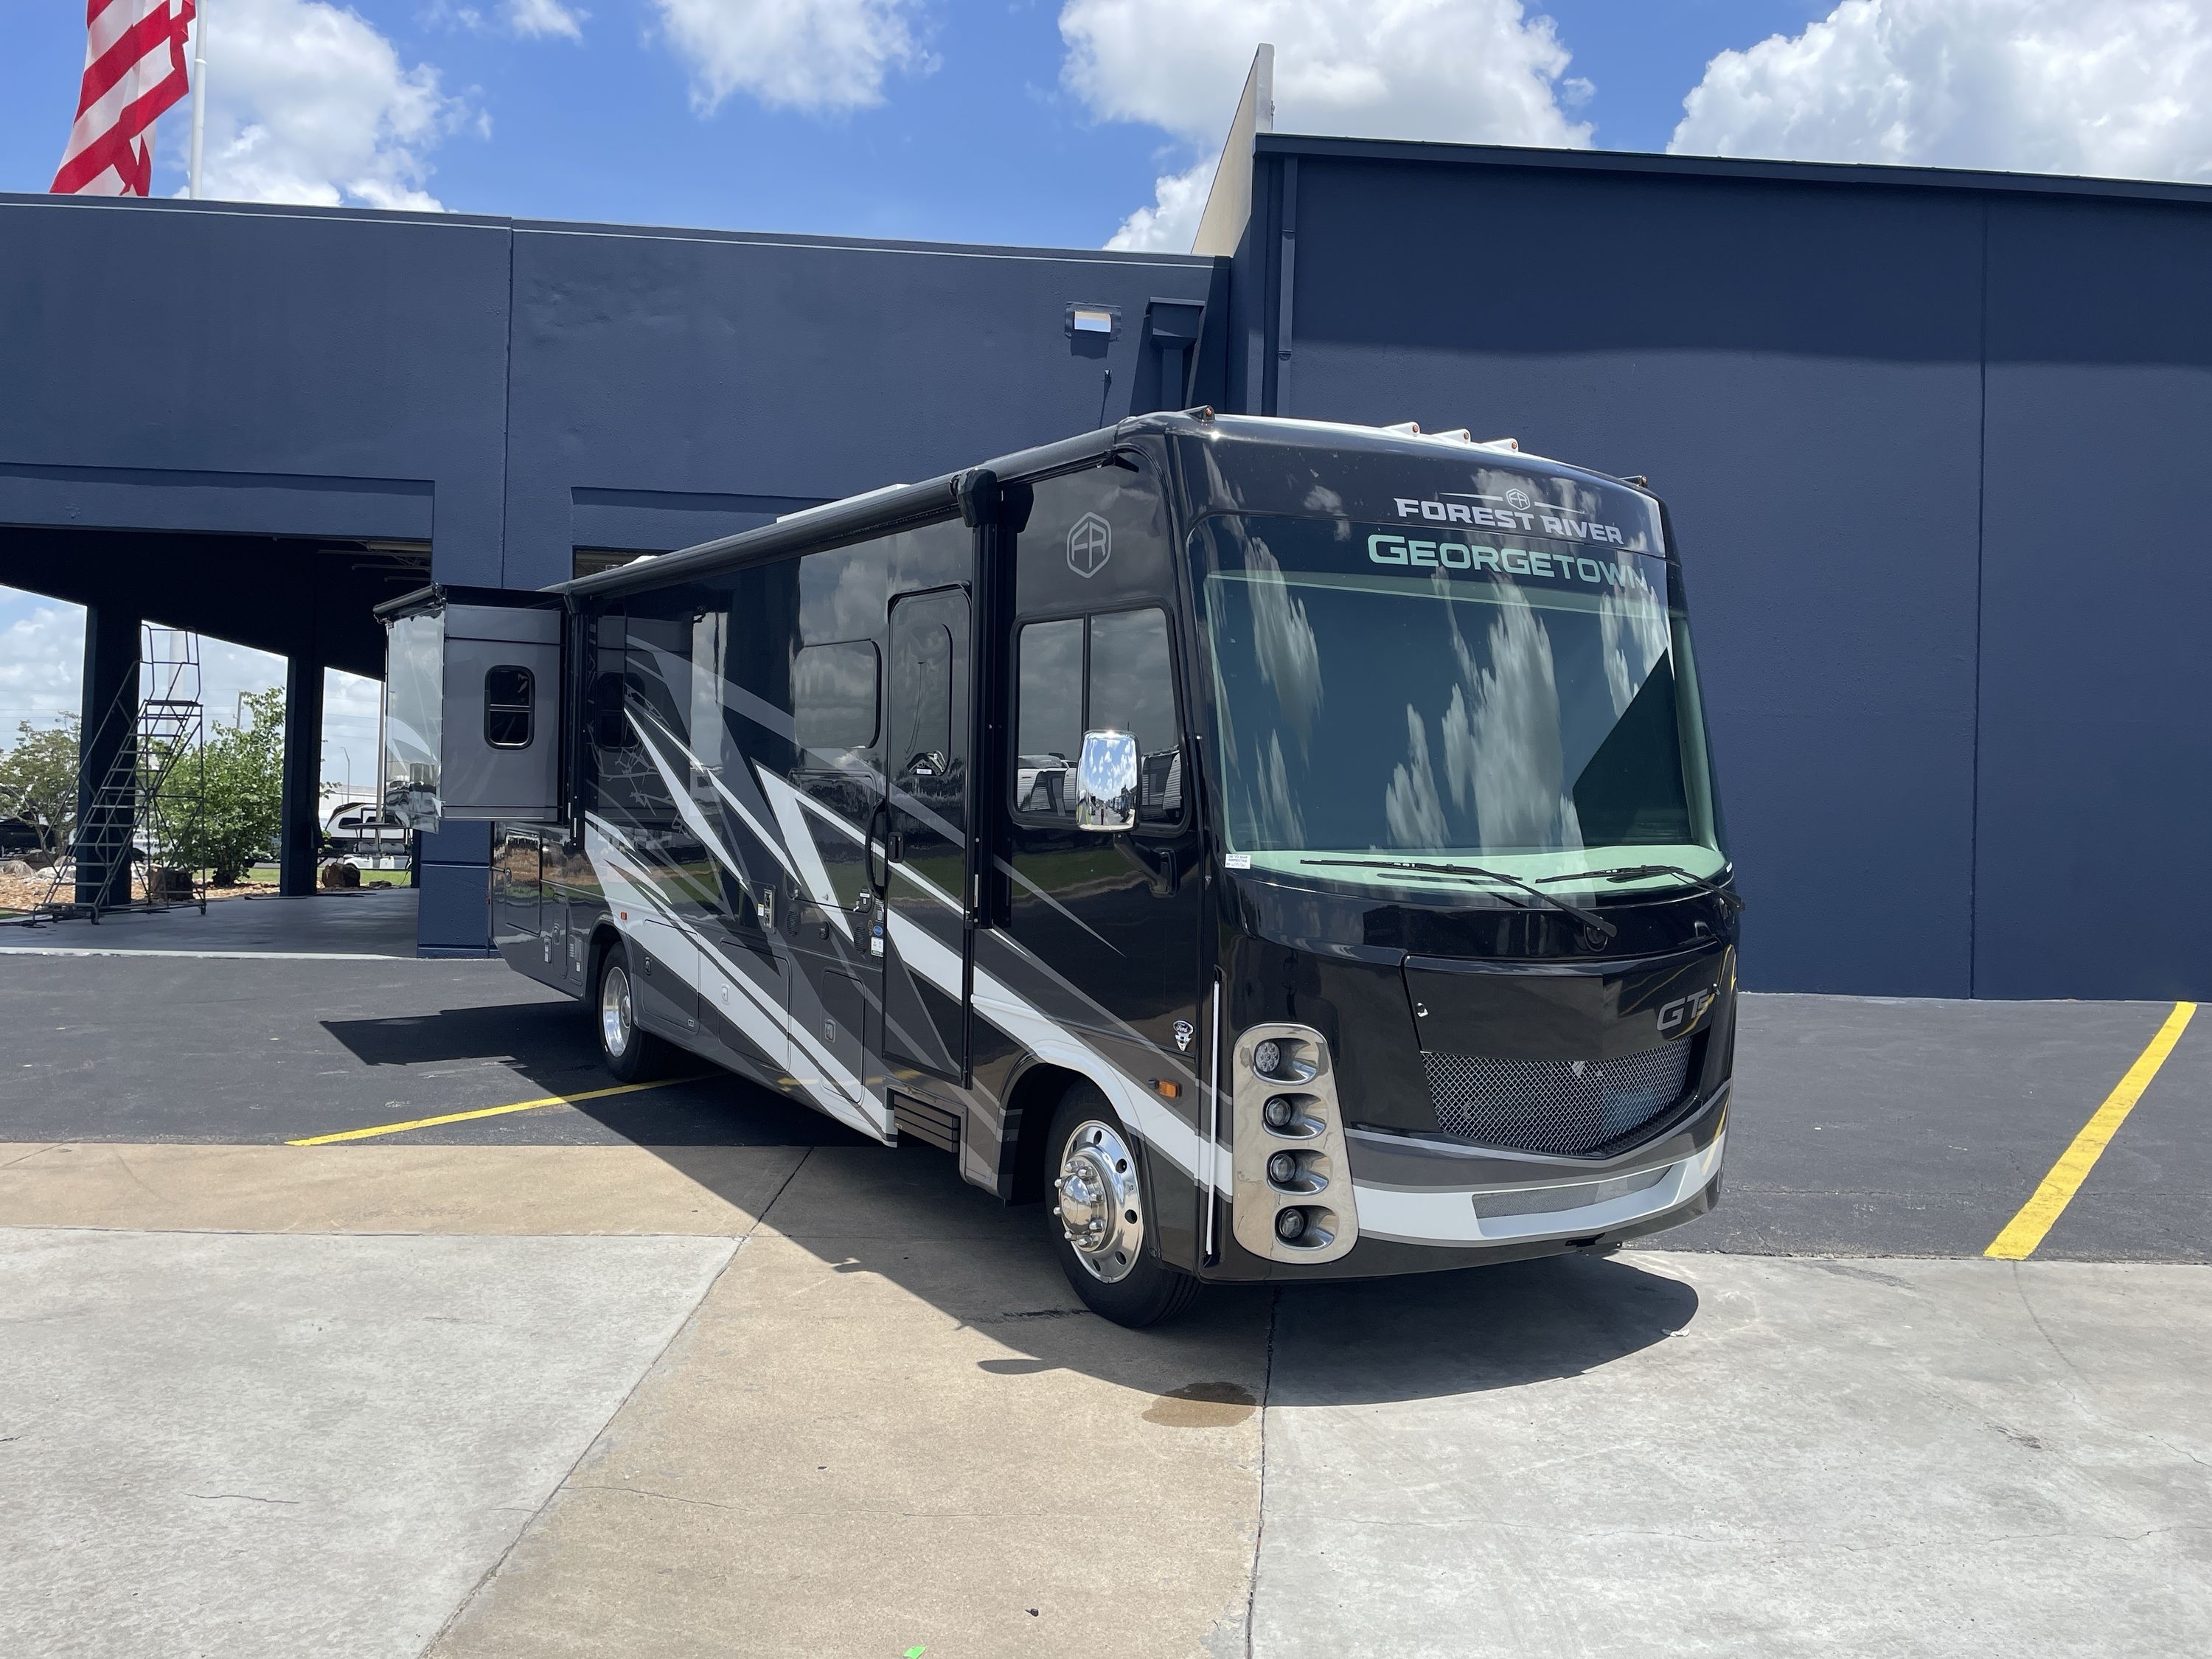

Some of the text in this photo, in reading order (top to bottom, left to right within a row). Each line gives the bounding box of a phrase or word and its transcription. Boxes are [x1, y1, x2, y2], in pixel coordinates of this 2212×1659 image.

[1394, 498, 1624, 545] FOREST RIVER
[1367, 534, 1649, 591] GEORGETOWN
[1176, 1022, 1189, 1033] Ford
